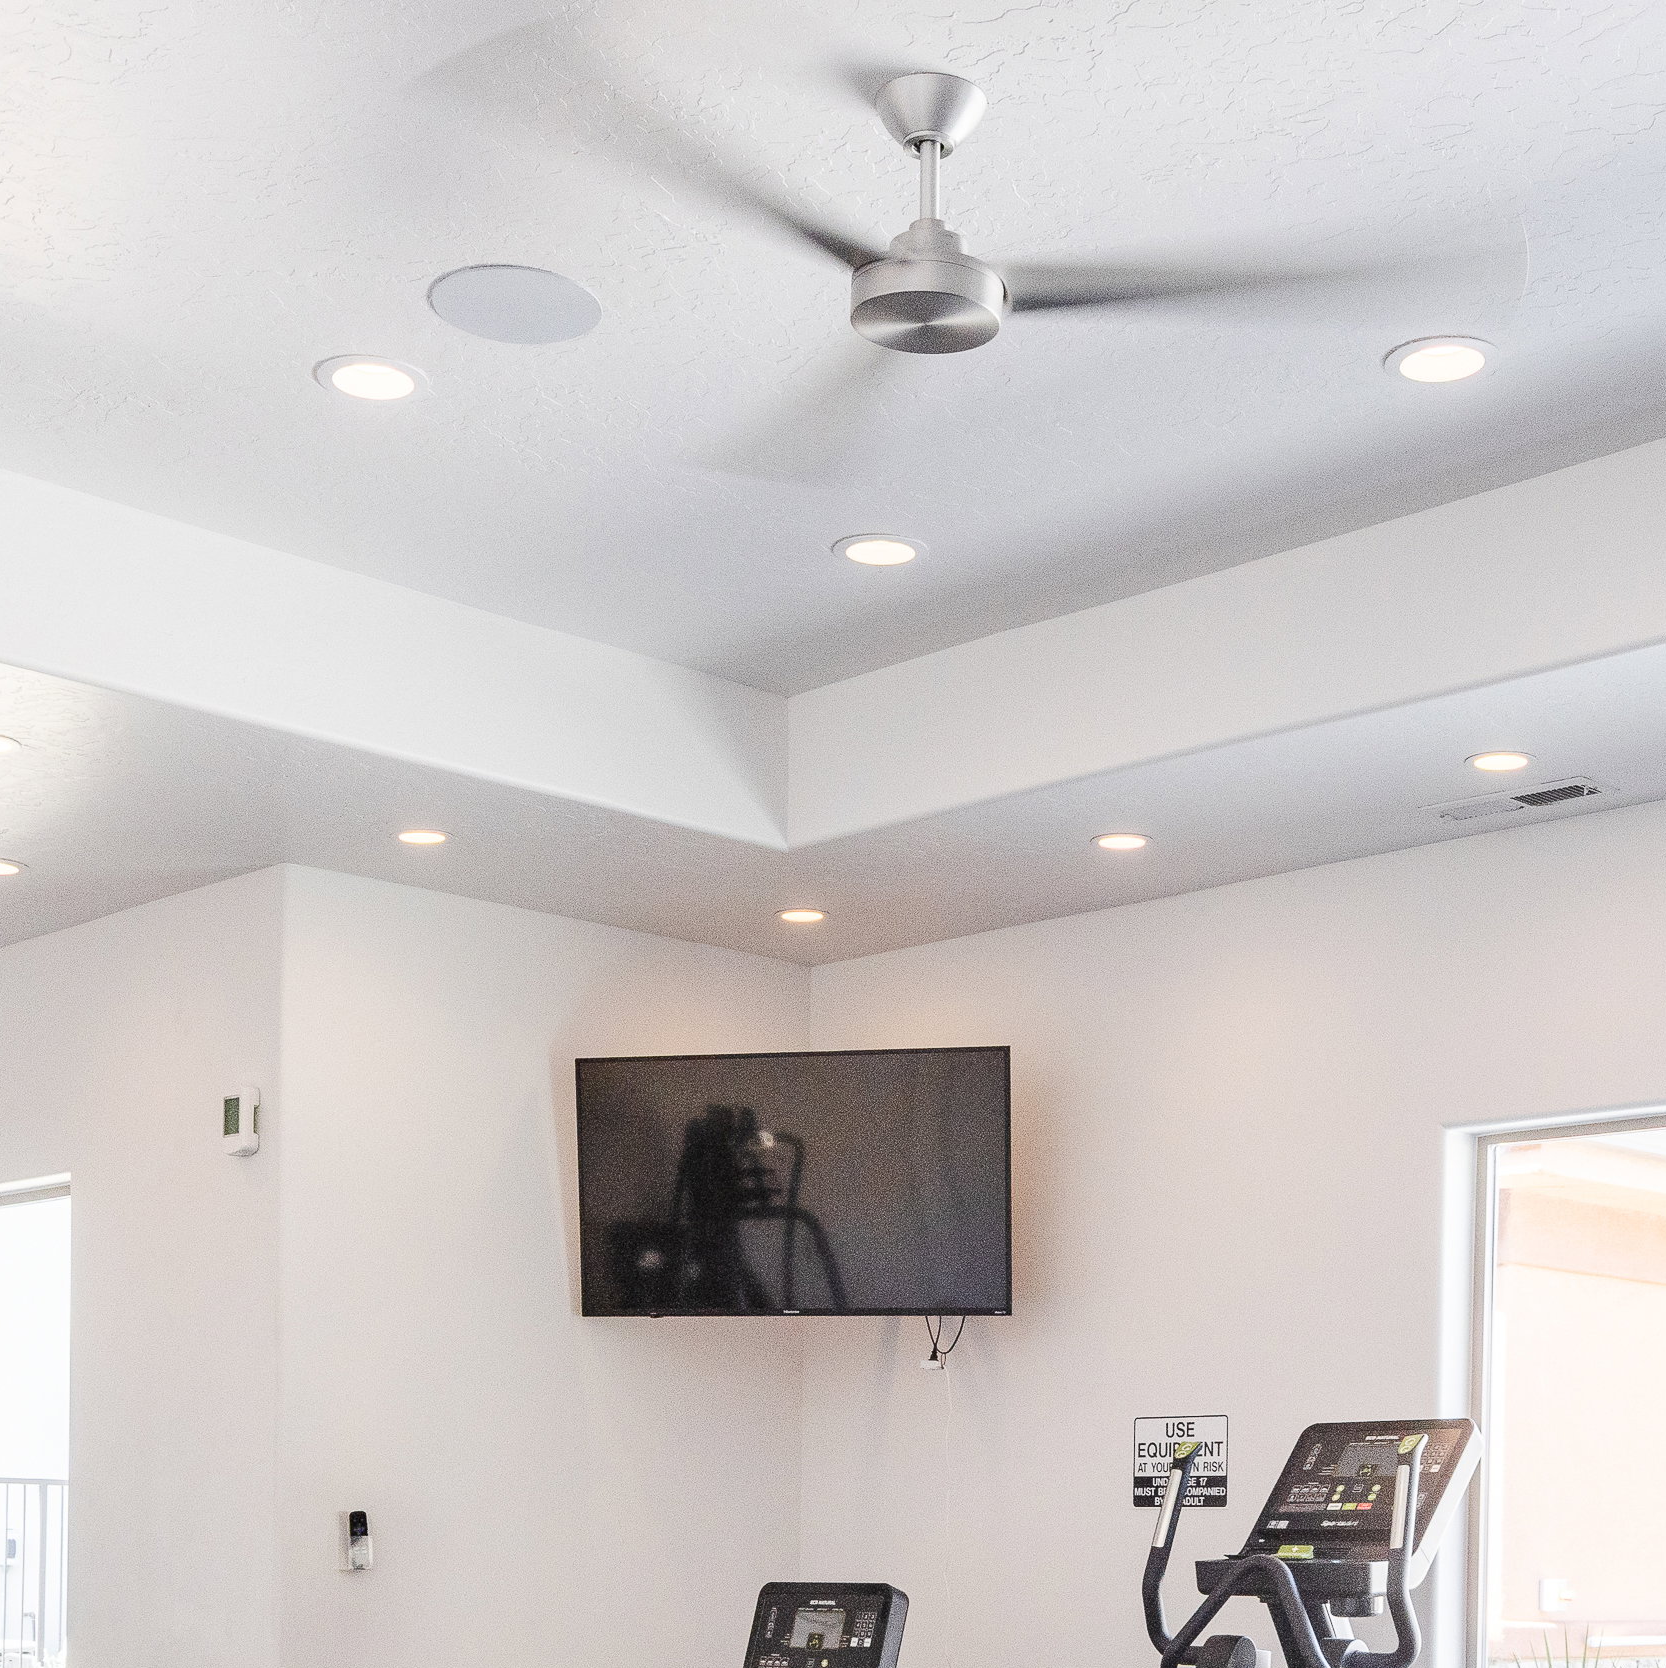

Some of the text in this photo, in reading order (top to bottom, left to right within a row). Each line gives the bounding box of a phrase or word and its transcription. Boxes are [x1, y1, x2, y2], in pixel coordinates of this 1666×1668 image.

[1165, 1421, 1195, 1438] USE
[1137, 1462, 1147, 1473] AT
[1203, 1461, 1224, 1472] RISK
[1199, 1477, 1208, 1486] 17
[1134, 1487, 1156, 1496] MUST
